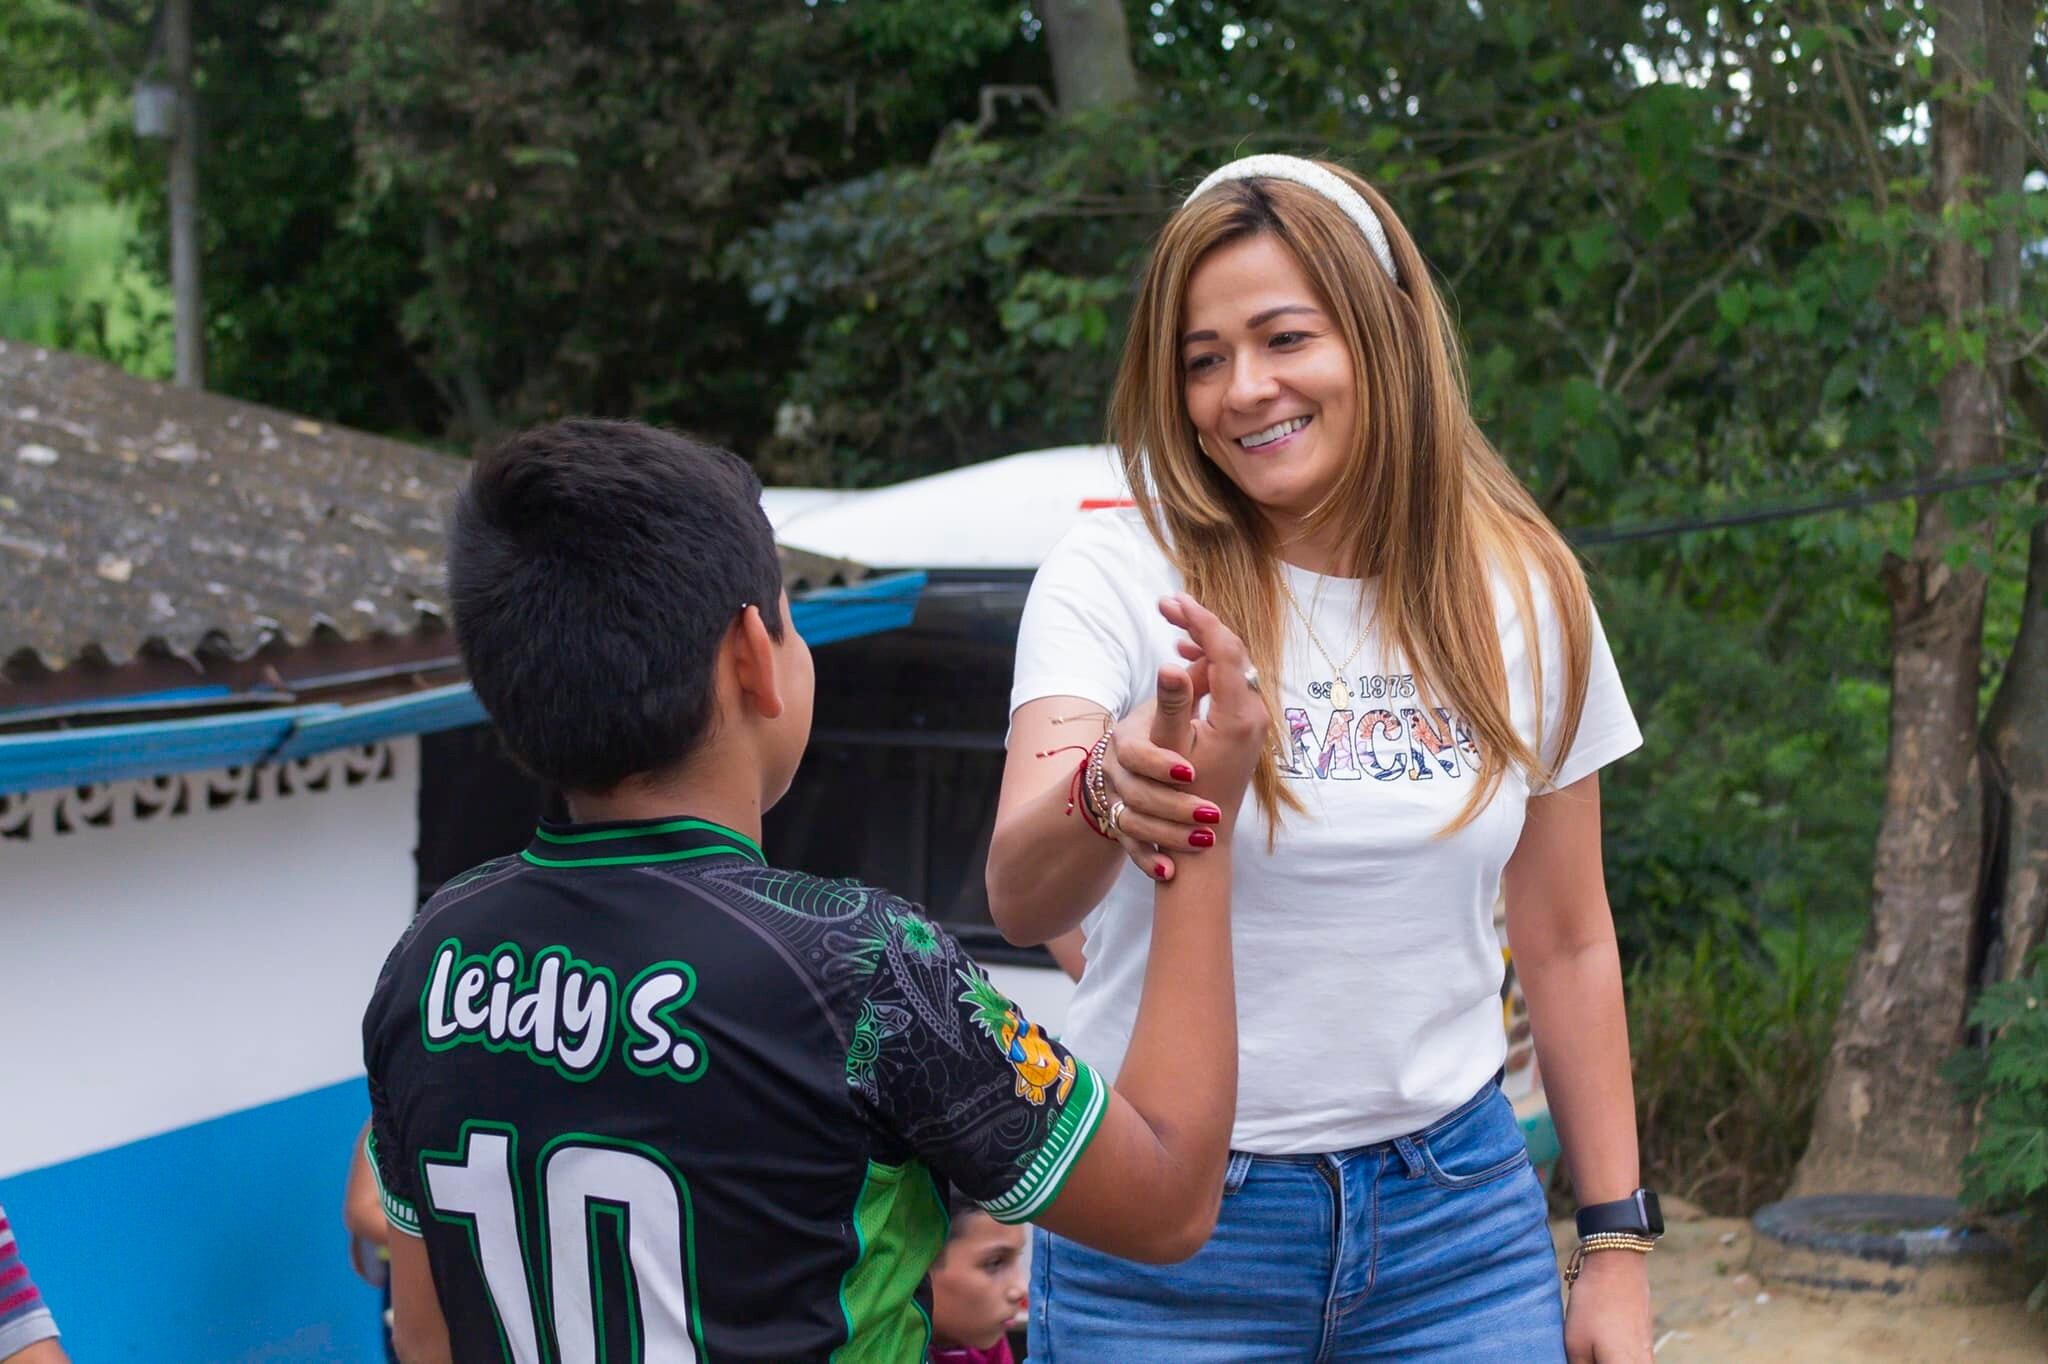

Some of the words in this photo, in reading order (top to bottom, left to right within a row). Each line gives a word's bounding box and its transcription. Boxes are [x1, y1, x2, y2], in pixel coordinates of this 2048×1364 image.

[1307, 677, 1355, 699] es.
[1359, 674, 1415, 699] 1975
[425, 945, 611, 1073] Leidy
[627, 969, 700, 1074] S.
[424, 1130, 700, 1364] 10
